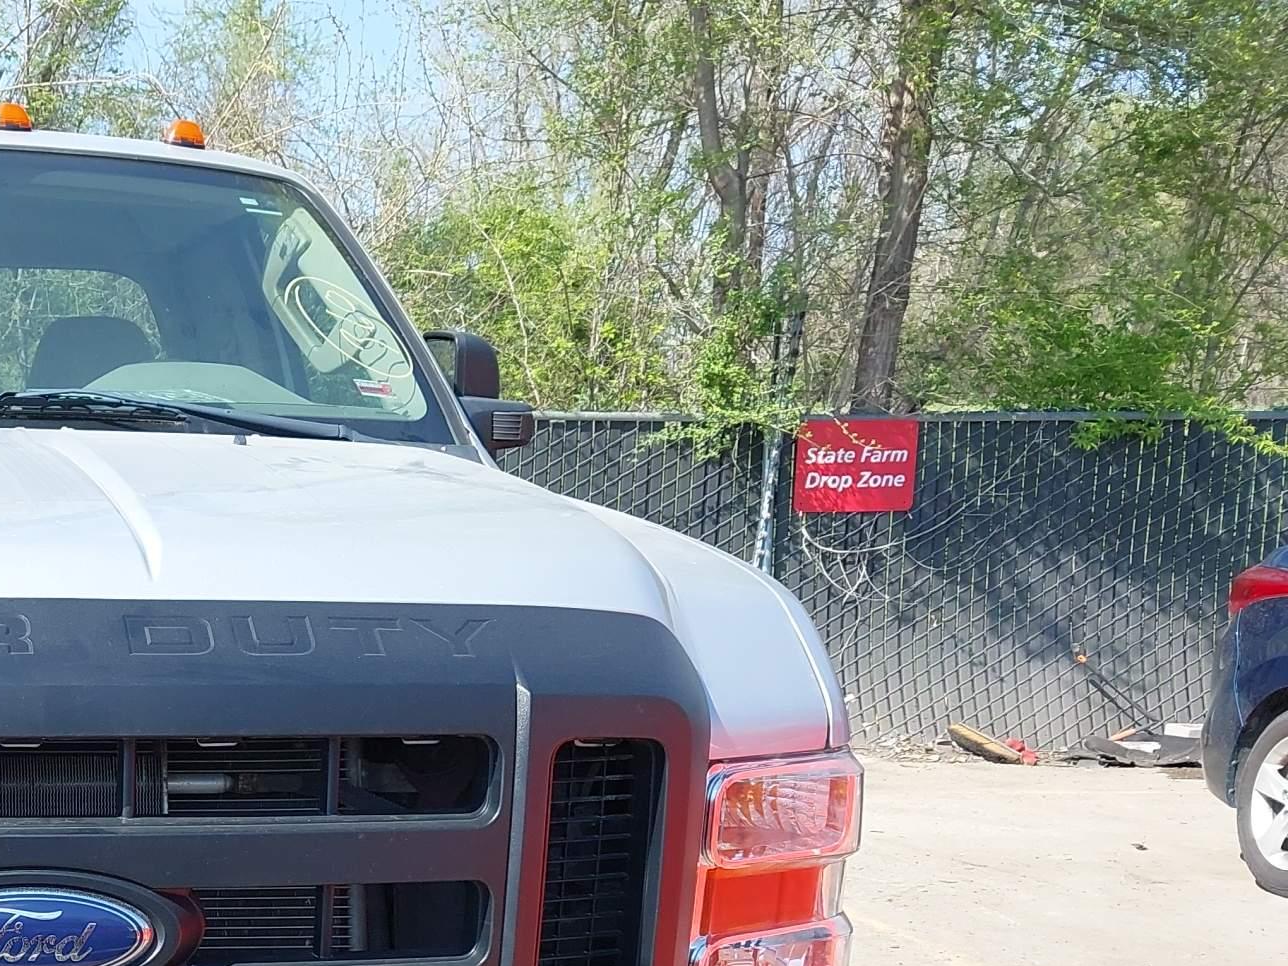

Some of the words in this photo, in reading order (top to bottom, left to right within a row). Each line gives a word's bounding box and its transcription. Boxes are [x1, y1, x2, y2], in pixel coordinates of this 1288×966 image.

[805, 447, 856, 464] State
[860, 447, 909, 463] Farm
[805, 472, 853, 492] Drop
[856, 471, 906, 488] Zone
[121, 614, 498, 658] DUTY
